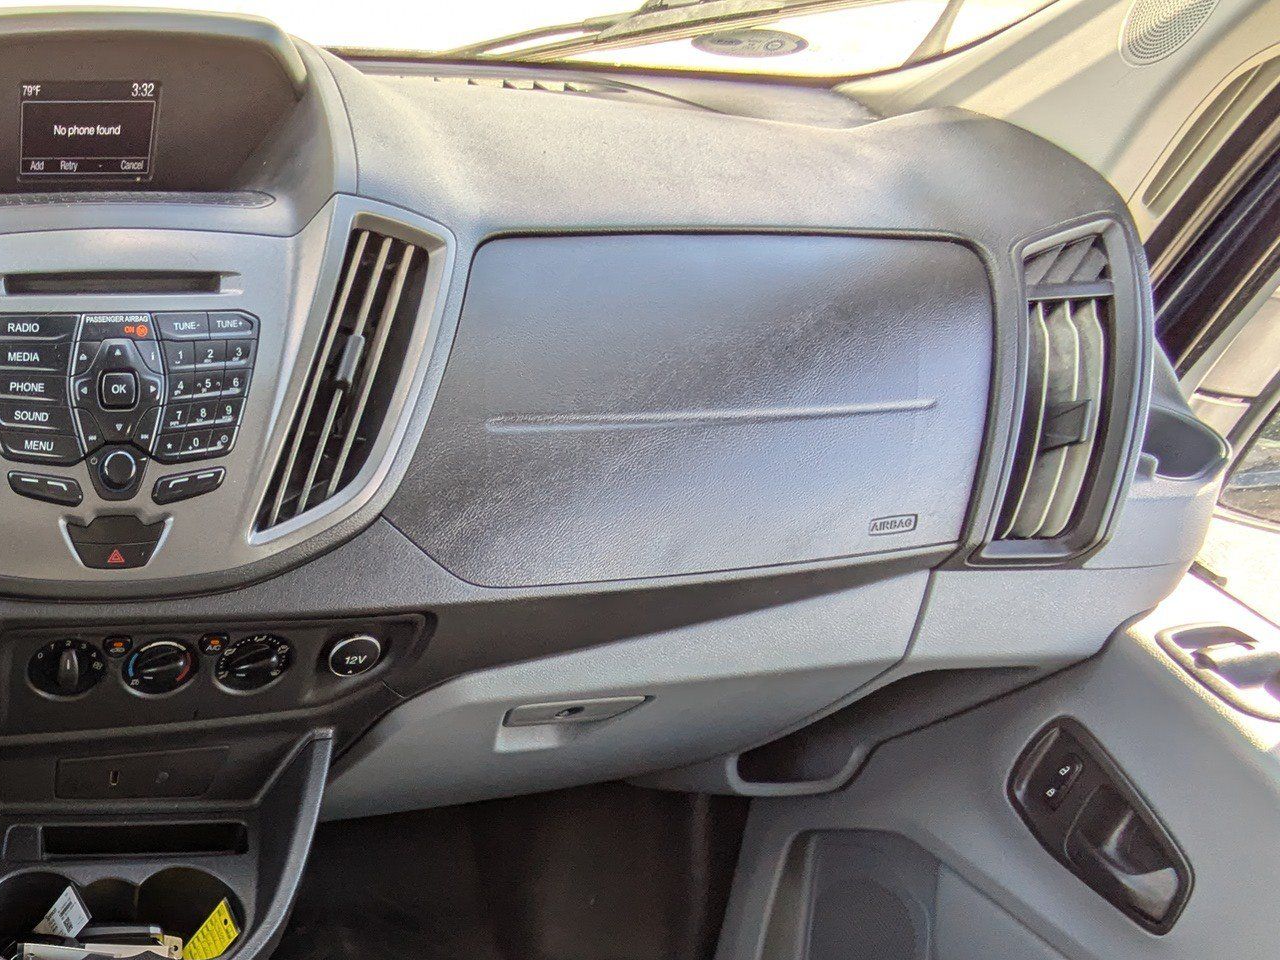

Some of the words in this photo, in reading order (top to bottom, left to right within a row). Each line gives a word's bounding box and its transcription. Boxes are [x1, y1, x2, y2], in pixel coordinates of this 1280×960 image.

[22, 85, 41, 97] 79°F
[131, 83, 154, 97] 3:32
[53, 124, 66, 136] No
[68, 125, 95, 138] phone
[96, 124, 121, 135] found
[30, 160, 45, 171] Add
[60, 161, 78, 172] Retry
[120, 160, 143, 170] Cancel
[85, 316, 124, 324] PASSENGER
[124, 315, 148, 323] AIRBAG
[7, 323, 40, 333] RADIO
[7, 352, 40, 362] MEDIA
[178, 350, 183, 360] 1
[207, 349, 214, 358] 2
[236, 347, 242, 357] 3
[177, 381, 184, 390] 4
[205, 378, 211, 388] 5
[232, 377, 239, 387] 6
[9, 382, 45, 393] PHONE
[111, 384, 127, 394] OK
[176, 410, 182, 420] 7
[200, 408, 207, 417] 8
[226, 405, 232, 415] 9
[14, 411, 49, 422] SOUND
[24, 440, 54, 451] MENU
[192, 437, 199, 447] 0
[870, 518, 912, 531] AIRBAG
[345, 655, 368, 665] 12V
